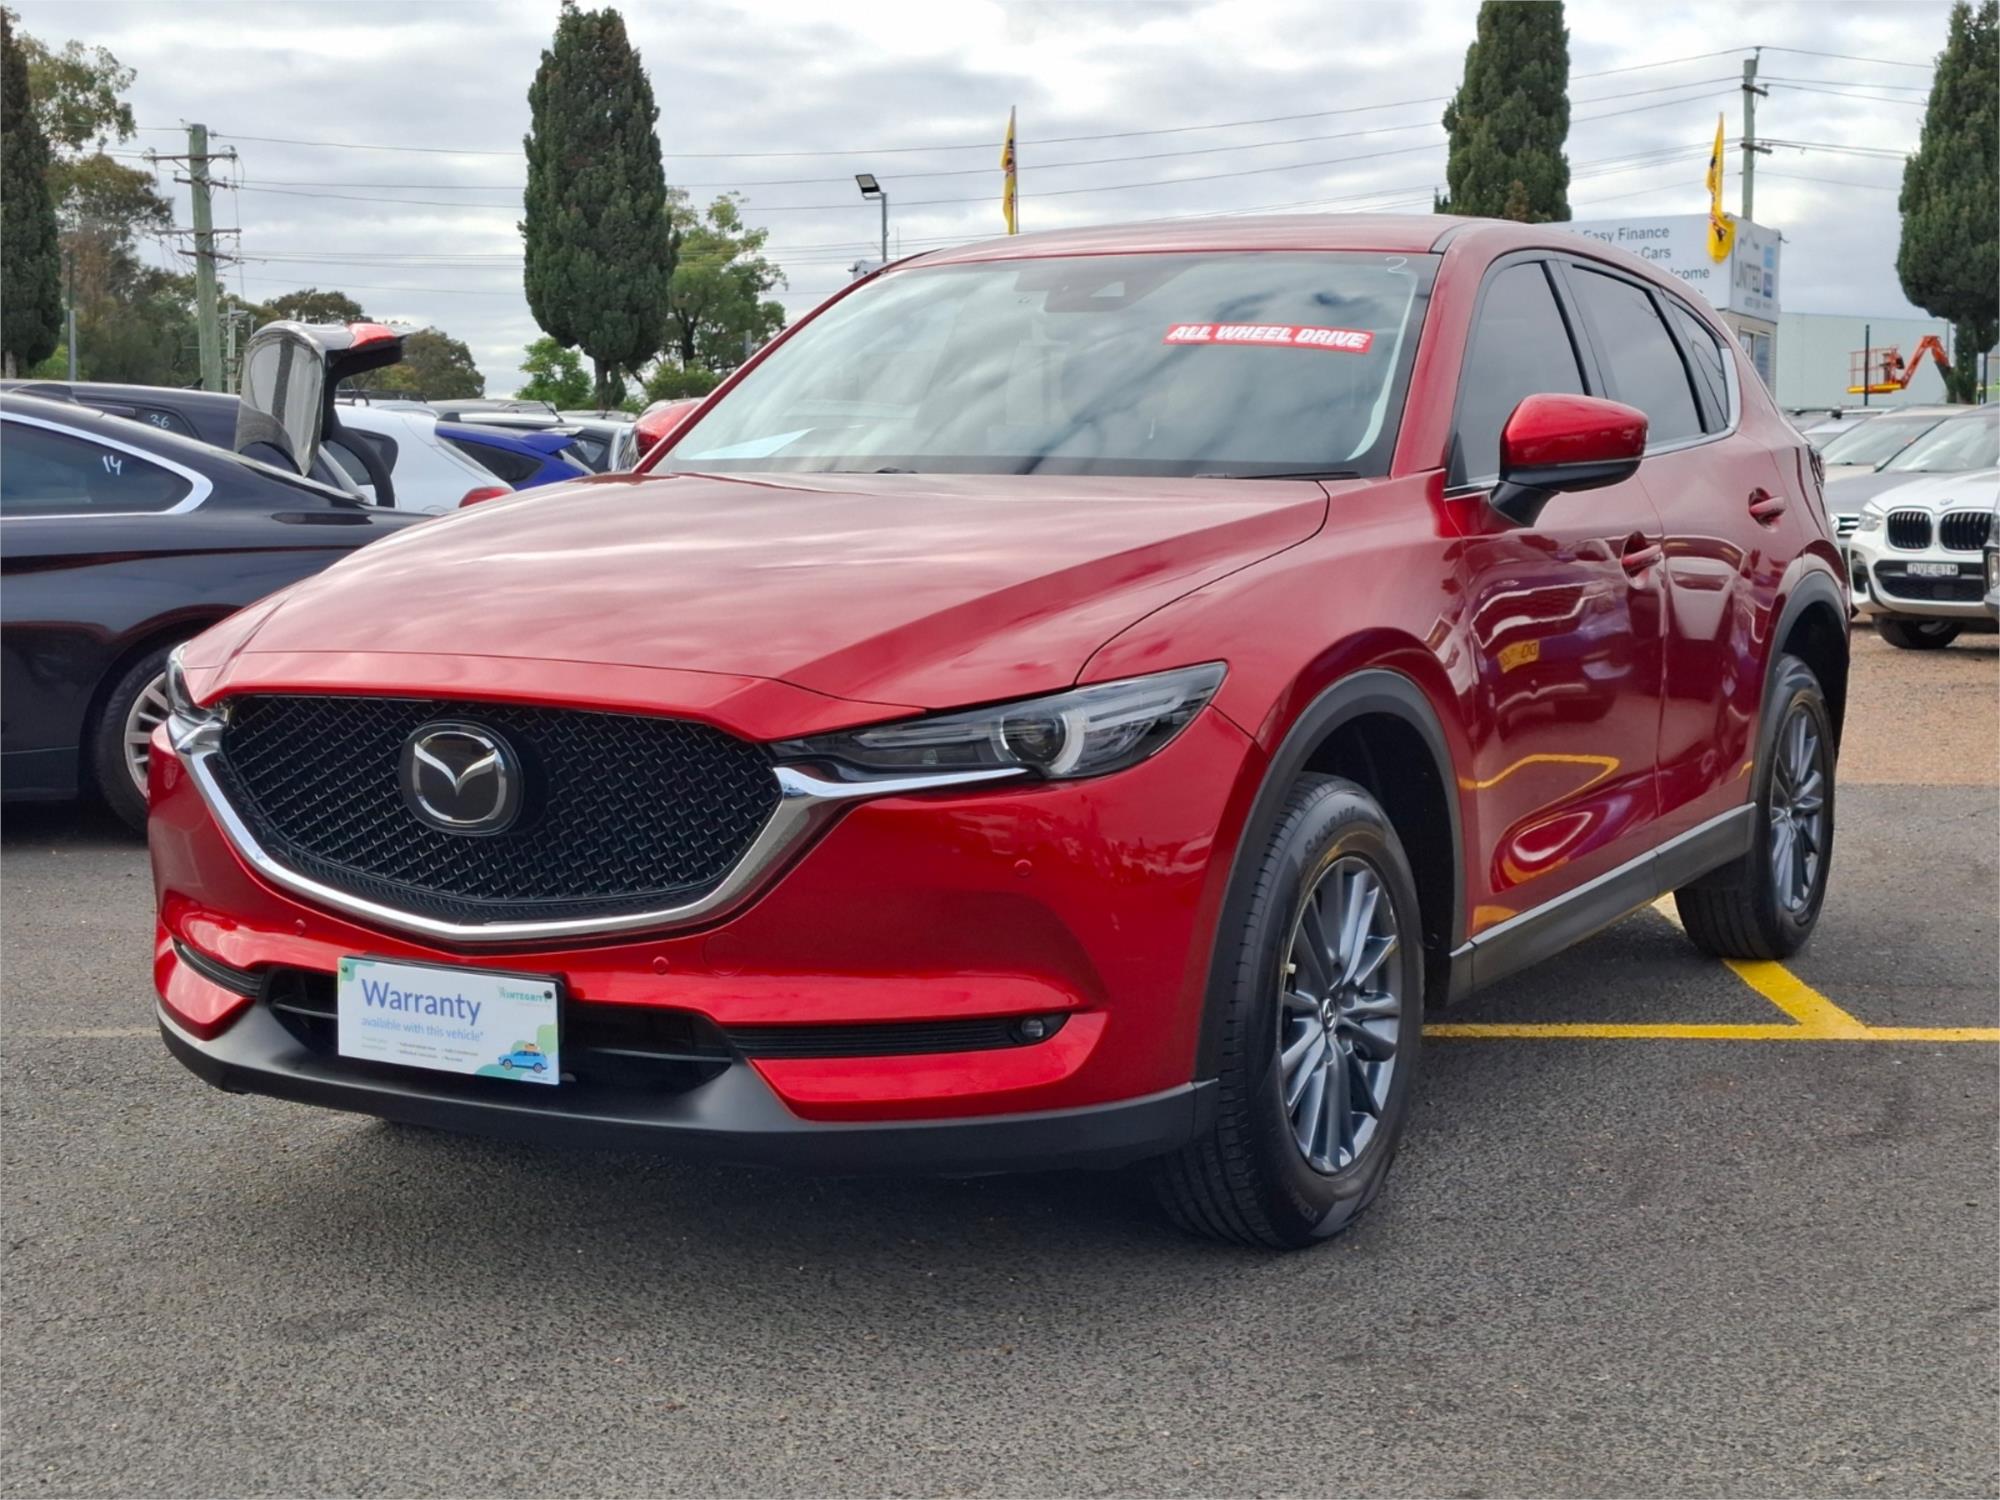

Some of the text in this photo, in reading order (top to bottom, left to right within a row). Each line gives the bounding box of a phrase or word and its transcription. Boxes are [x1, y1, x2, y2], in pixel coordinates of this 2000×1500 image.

[1618, 226, 1670, 241] Finance
[1641, 246, 1672, 259] Cars
[1385, 256, 1408, 275] 2
[1167, 325, 1371, 349] ALL WHEEL DRIVE
[150, 414, 170, 429] 36
[102, 455, 122, 476] 14
[360, 978, 482, 1027] Warranty
[361, 1017, 402, 1031] available
[403, 1022, 425, 1034] with
[426, 1025, 445, 1038] this
